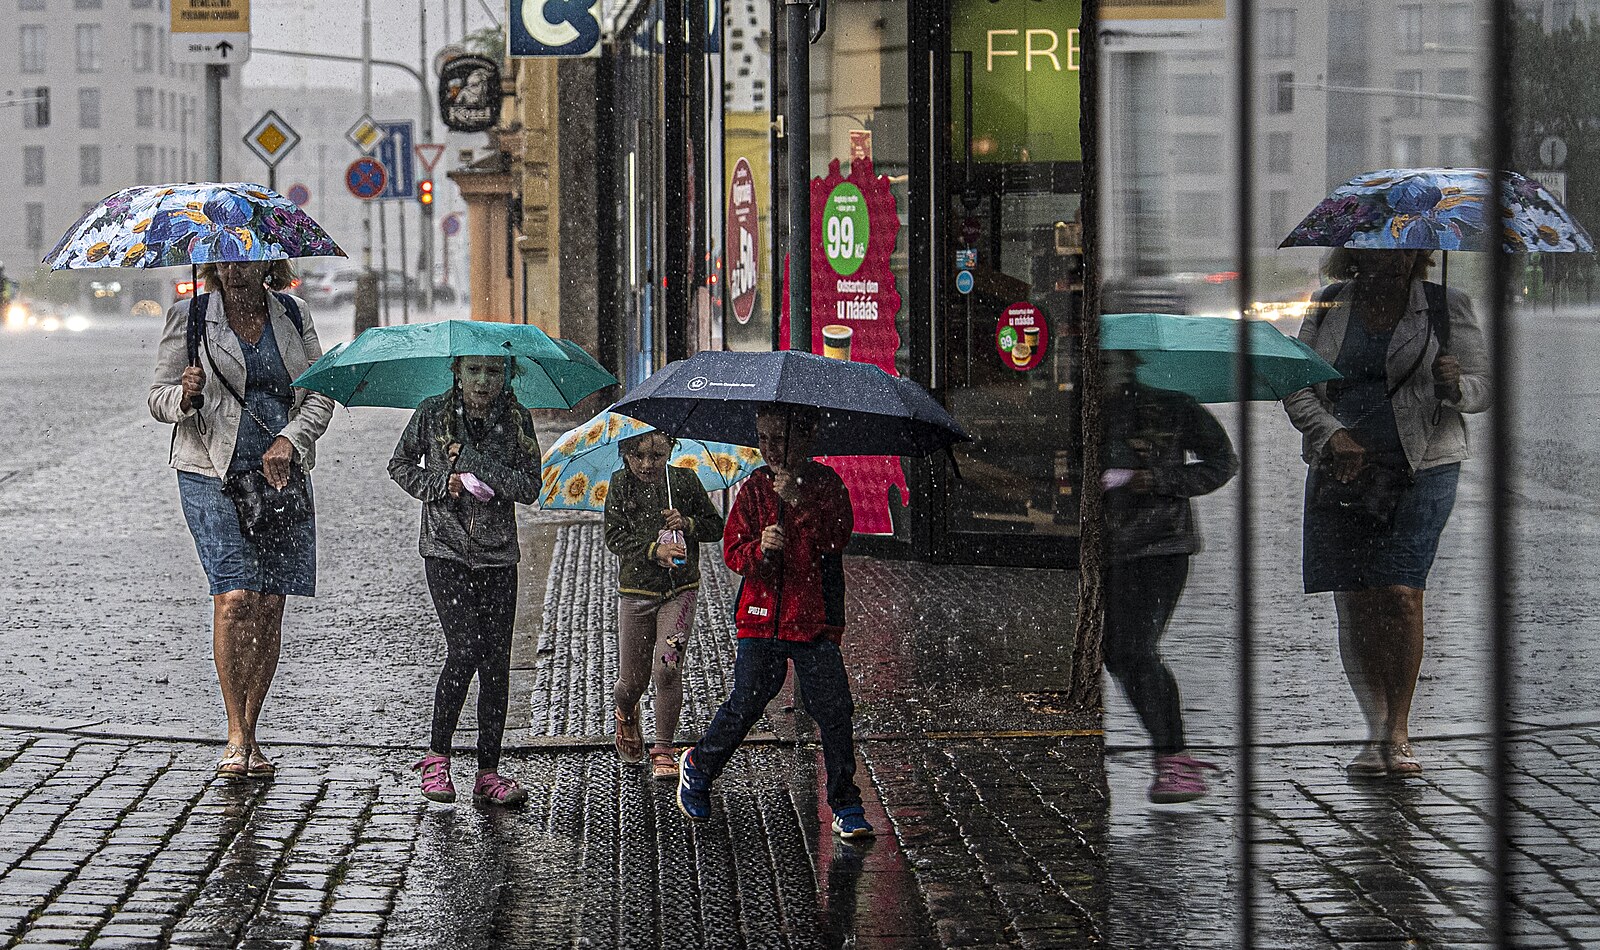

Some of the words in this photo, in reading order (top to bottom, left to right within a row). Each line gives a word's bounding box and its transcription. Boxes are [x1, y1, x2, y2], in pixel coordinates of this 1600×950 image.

[827, 216, 854, 259] 99
[837, 279, 866, 294] Odstartuj
[867, 279, 878, 293] den
[837, 300, 845, 319] u
[846, 295, 878, 320] nááás
[1000, 335, 1012, 349] 99
